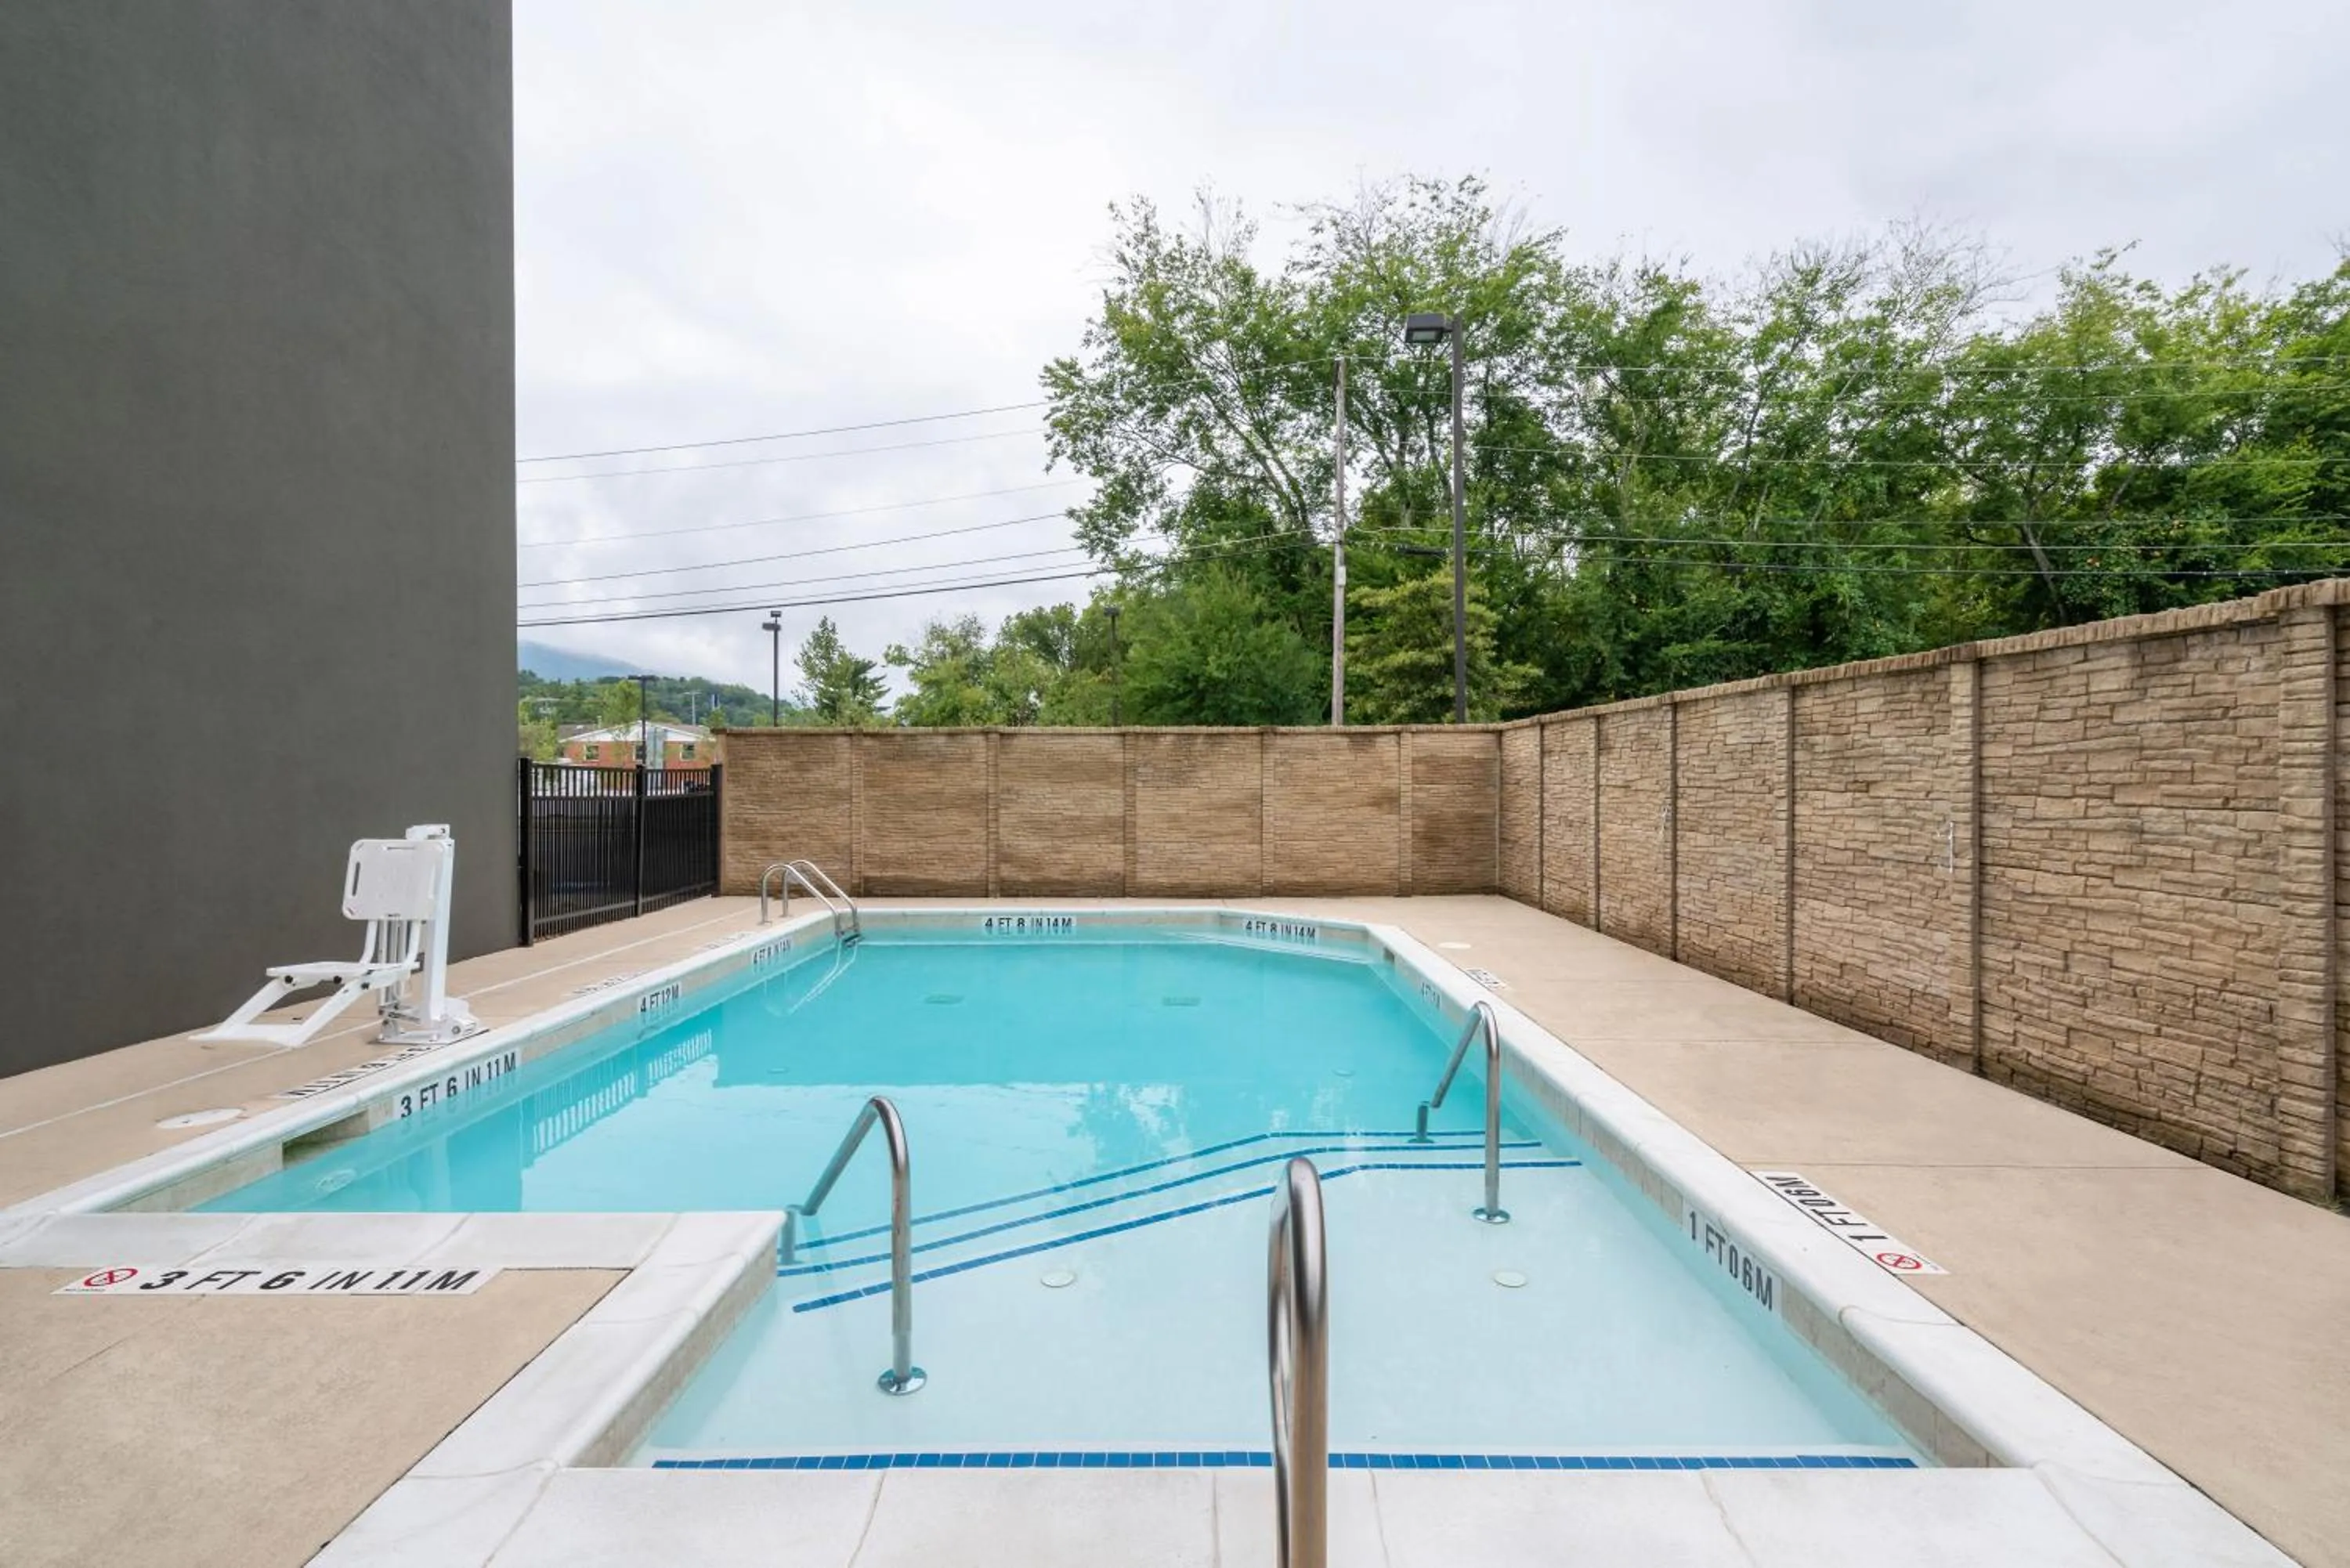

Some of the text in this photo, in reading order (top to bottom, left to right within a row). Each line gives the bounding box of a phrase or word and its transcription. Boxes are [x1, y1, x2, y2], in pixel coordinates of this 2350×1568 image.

[985, 917, 992, 927] 4
[998, 917, 1012, 927] FT
[1246, 920, 1252, 930] 4
[1256, 920, 1266, 933] FT
[640, 996, 646, 1013] 4
[649, 992, 660, 1009] FT
[400, 1095, 412, 1118] 3
[419, 1082, 439, 1110] FT
[446, 1075, 457, 1098] 6
[465, 1065, 480, 1091] IN
[1690, 1211, 1696, 1241] 1
[139, 1270, 190, 1290] 3
[184, 1270, 262, 1291] FT
[258, 1270, 306, 1290] 6
[306, 1270, 376, 1290] IN
